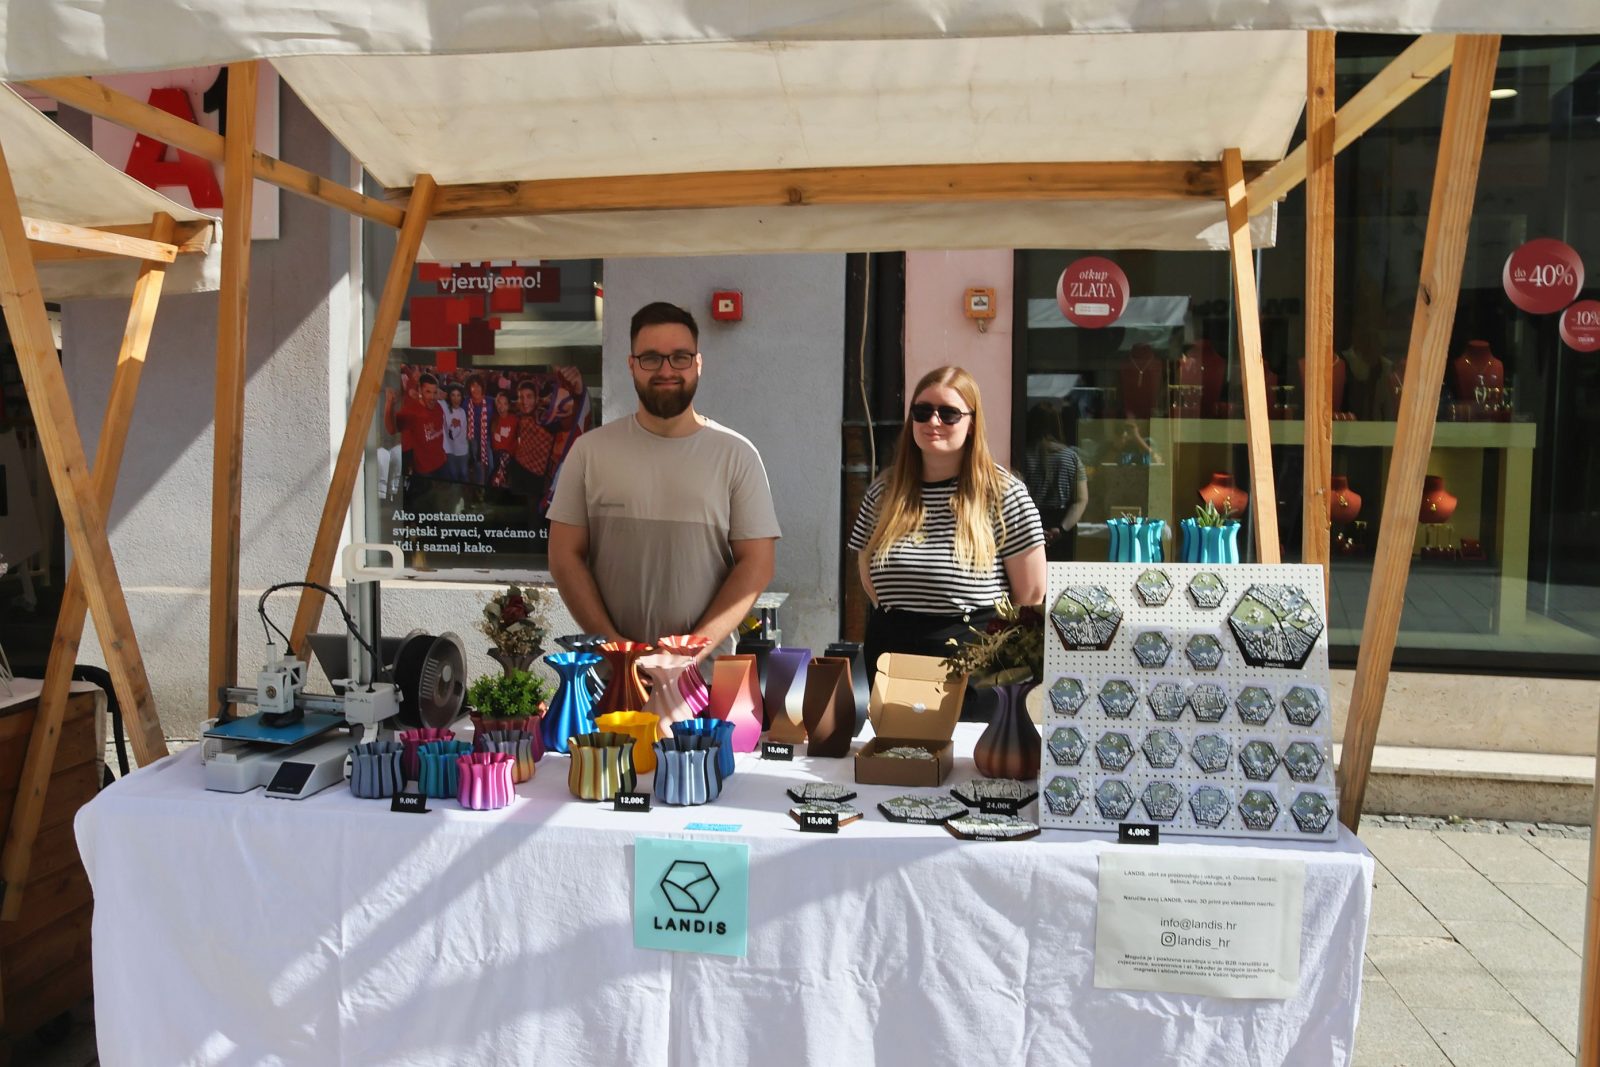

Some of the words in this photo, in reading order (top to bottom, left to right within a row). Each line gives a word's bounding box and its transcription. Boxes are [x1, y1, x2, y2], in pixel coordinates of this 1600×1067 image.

[439, 271, 541, 293] vjerujemo!
[1079, 269, 1108, 282] otkup
[1514, 267, 1526, 278] do
[1529, 264, 1573, 287] 40%
[1070, 282, 1116, 298] ZLATA
[392, 510, 415, 521] Ako
[418, 512, 484, 523] postanemo
[392, 526, 437, 538] svjetski
[440, 527, 481, 539] prvaci,
[484, 527, 536, 538] vraćamo
[424, 542, 461, 554] saznaj
[464, 542, 496, 553] kako.
[620, 796, 644, 804] 12,00€
[986, 802, 1011, 810] 24,00€
[1128, 828, 1150, 836] 4,00€
[654, 916, 727, 935] LANDIS
[1160, 917, 1237, 930] info@landis.hr
[1178, 936, 1230, 950] landis_hr
